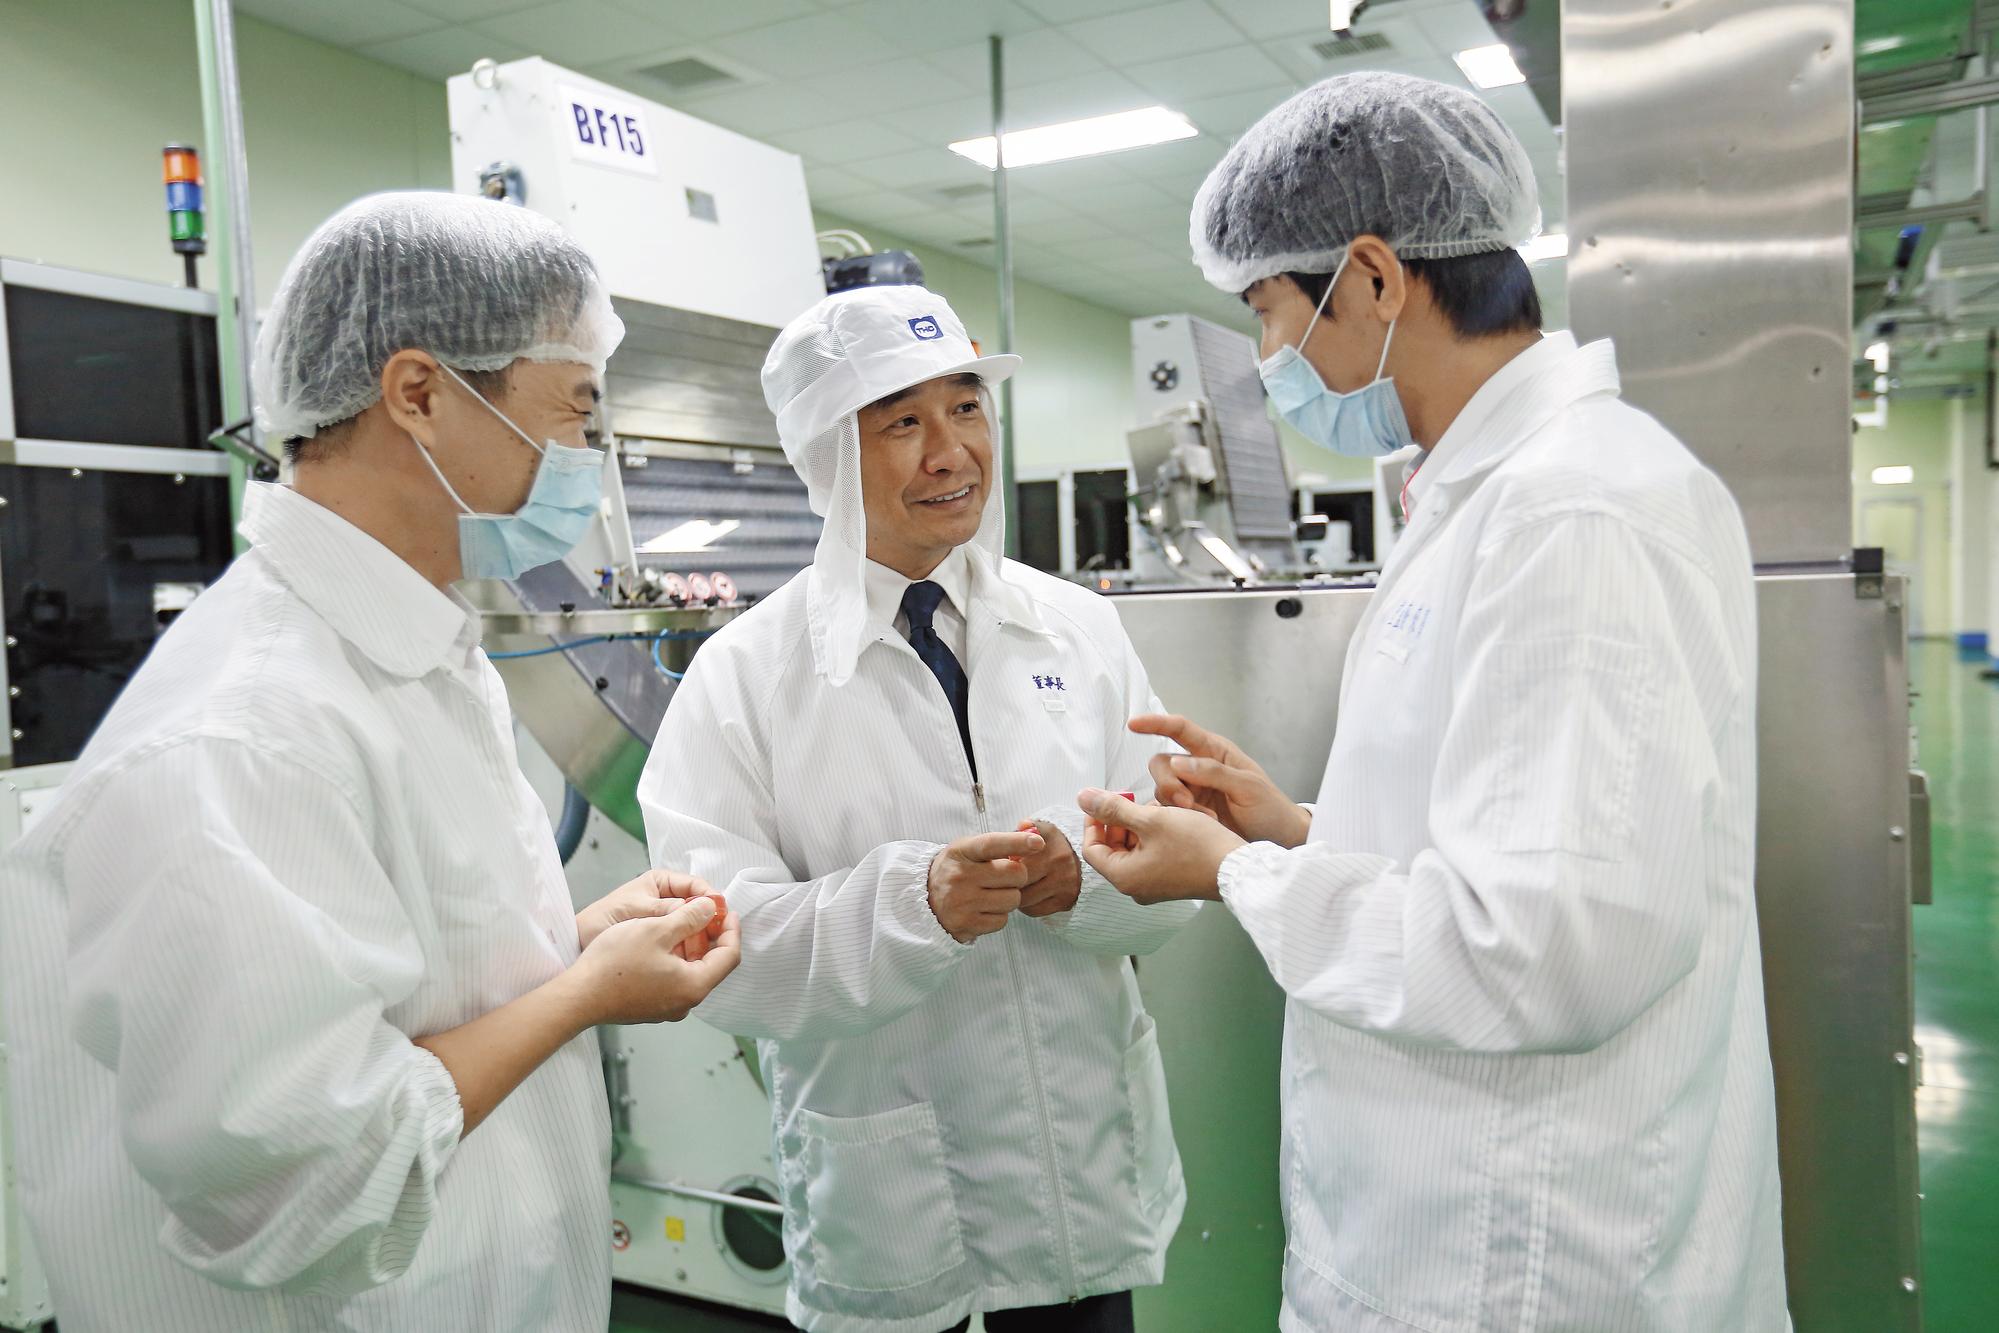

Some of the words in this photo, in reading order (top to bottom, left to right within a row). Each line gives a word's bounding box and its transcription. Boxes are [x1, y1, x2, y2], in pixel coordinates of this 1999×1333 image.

[572, 103, 644, 156] BF15
[1032, 675, 1067, 691] 董事長
